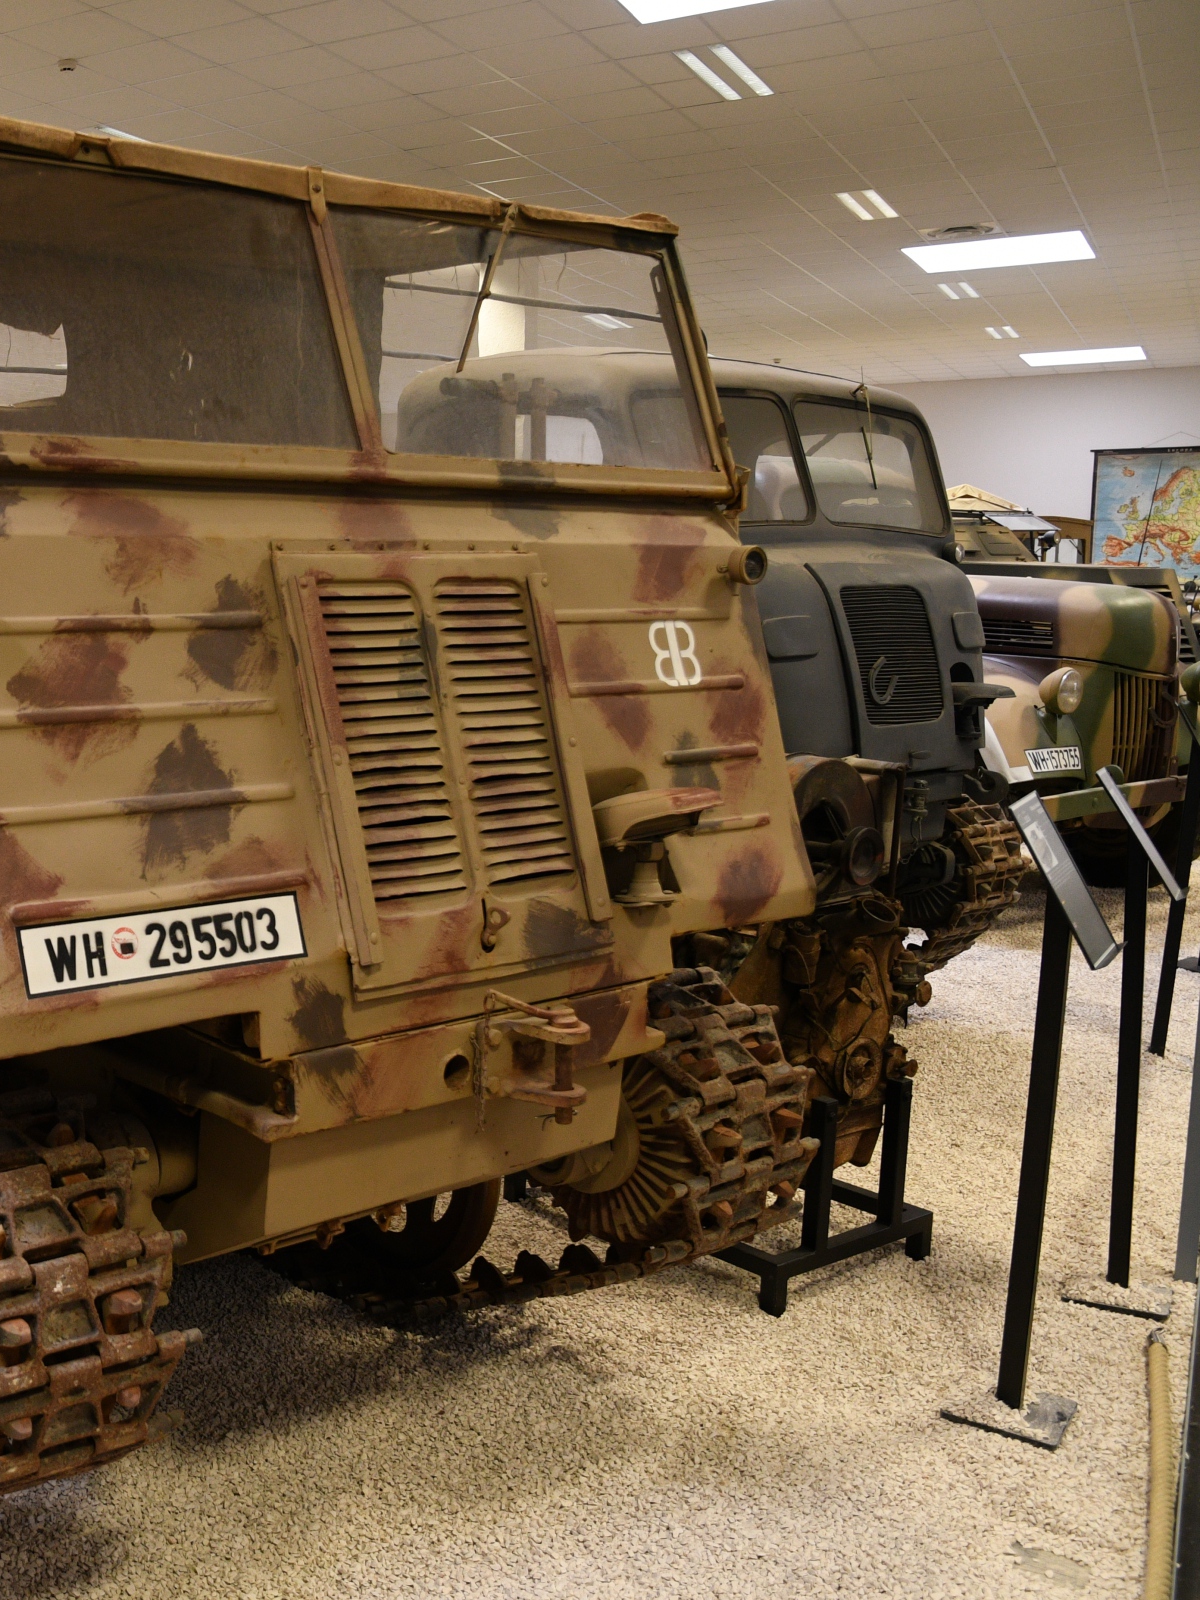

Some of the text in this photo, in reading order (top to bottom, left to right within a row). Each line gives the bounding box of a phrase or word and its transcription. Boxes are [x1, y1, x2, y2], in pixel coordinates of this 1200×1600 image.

[1027, 747, 1080, 771] WH-1573755
[44, 907, 280, 983] WH 295503
